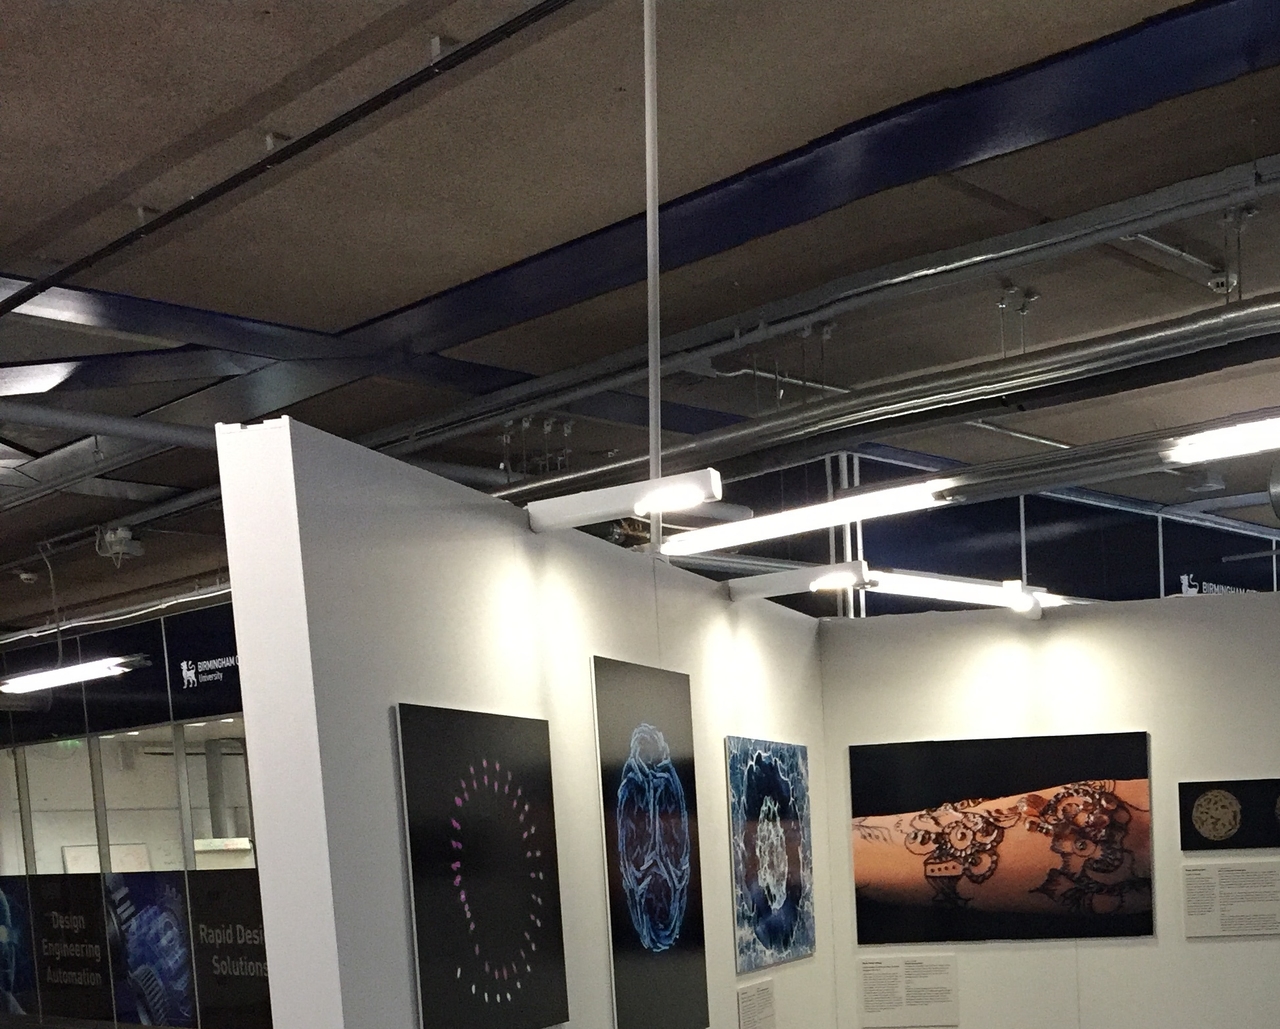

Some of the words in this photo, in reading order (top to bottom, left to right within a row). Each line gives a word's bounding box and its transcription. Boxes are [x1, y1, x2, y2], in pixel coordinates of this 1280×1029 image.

[198, 656, 236, 672] BIRMINGHAM
[199, 671, 223, 683] University
[52, 911, 85, 933] Design
[199, 924, 234, 949] Rapid
[42, 939, 101, 962] Engineering
[47, 966, 102, 986] Automation
[212, 954, 269, 977] Solutions
